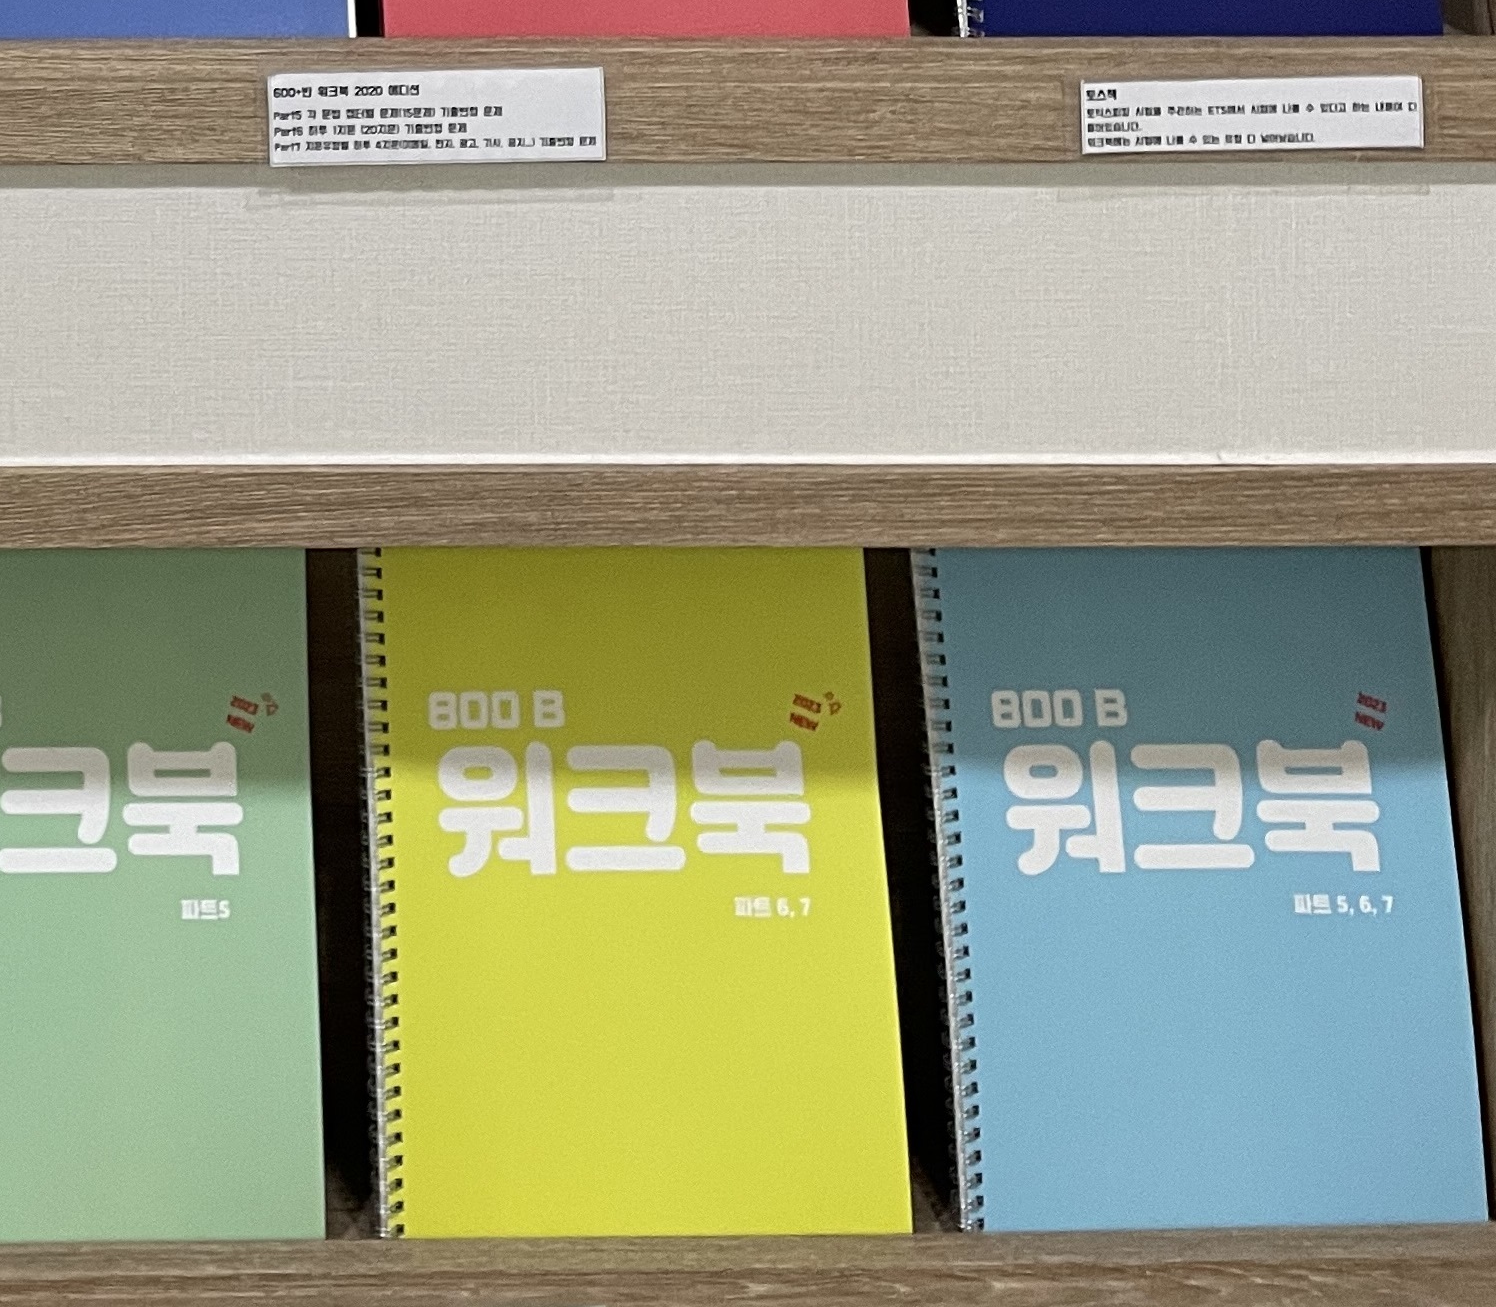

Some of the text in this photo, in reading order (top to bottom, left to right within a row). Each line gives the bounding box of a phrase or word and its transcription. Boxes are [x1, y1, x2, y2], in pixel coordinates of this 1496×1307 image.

[354, 85, 384, 97] 2020
[428, 689, 565, 730] 800 B
[991, 688, 1129, 729] 800 B
[438, 740, 811, 878] 워크북
[1003, 739, 1381, 876] 워크북
[734, 896, 771, 918] 파트
[800, 898, 811, 916] 7
[1293, 893, 1332, 915] 파트
[1381, 895, 1394, 914] 7
